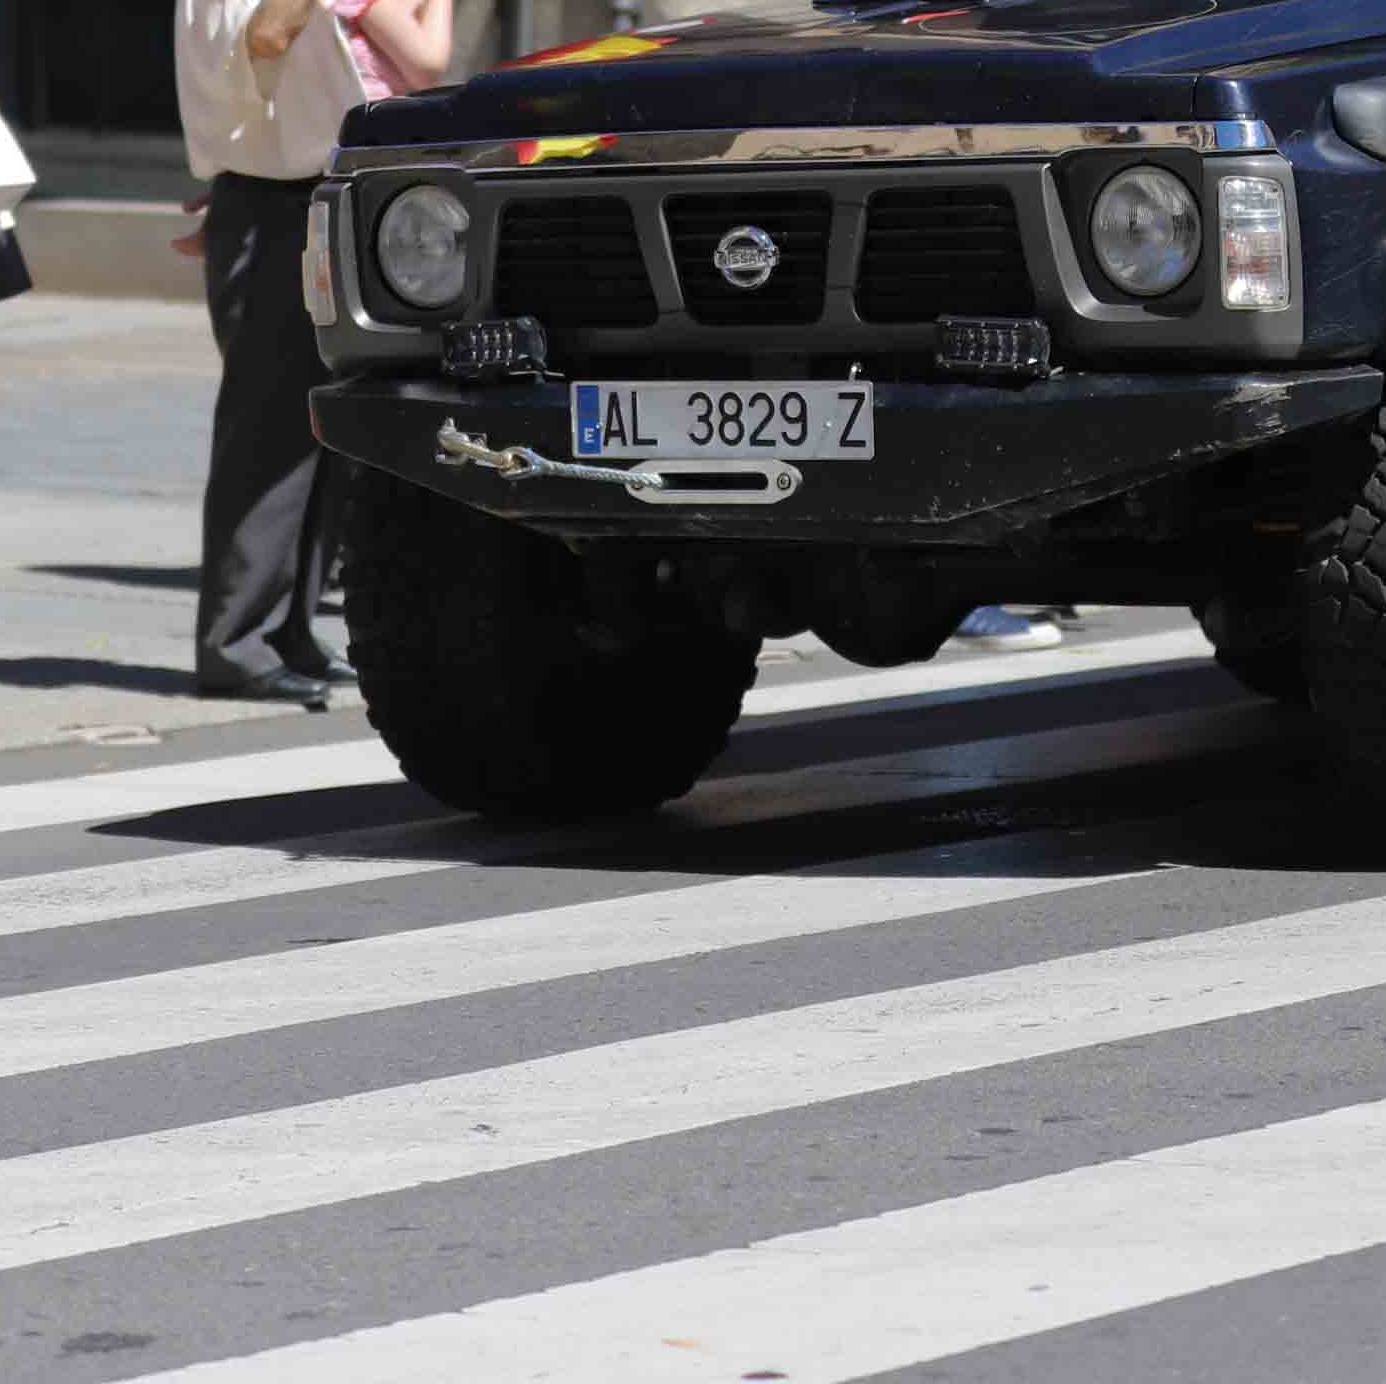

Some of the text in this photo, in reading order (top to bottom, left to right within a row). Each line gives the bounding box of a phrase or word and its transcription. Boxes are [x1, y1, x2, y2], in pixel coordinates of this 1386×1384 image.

[716, 249, 769, 266] NISSAN
[603, 391, 867, 448] AL 3829 Z
[583, 427, 595, 444] E
